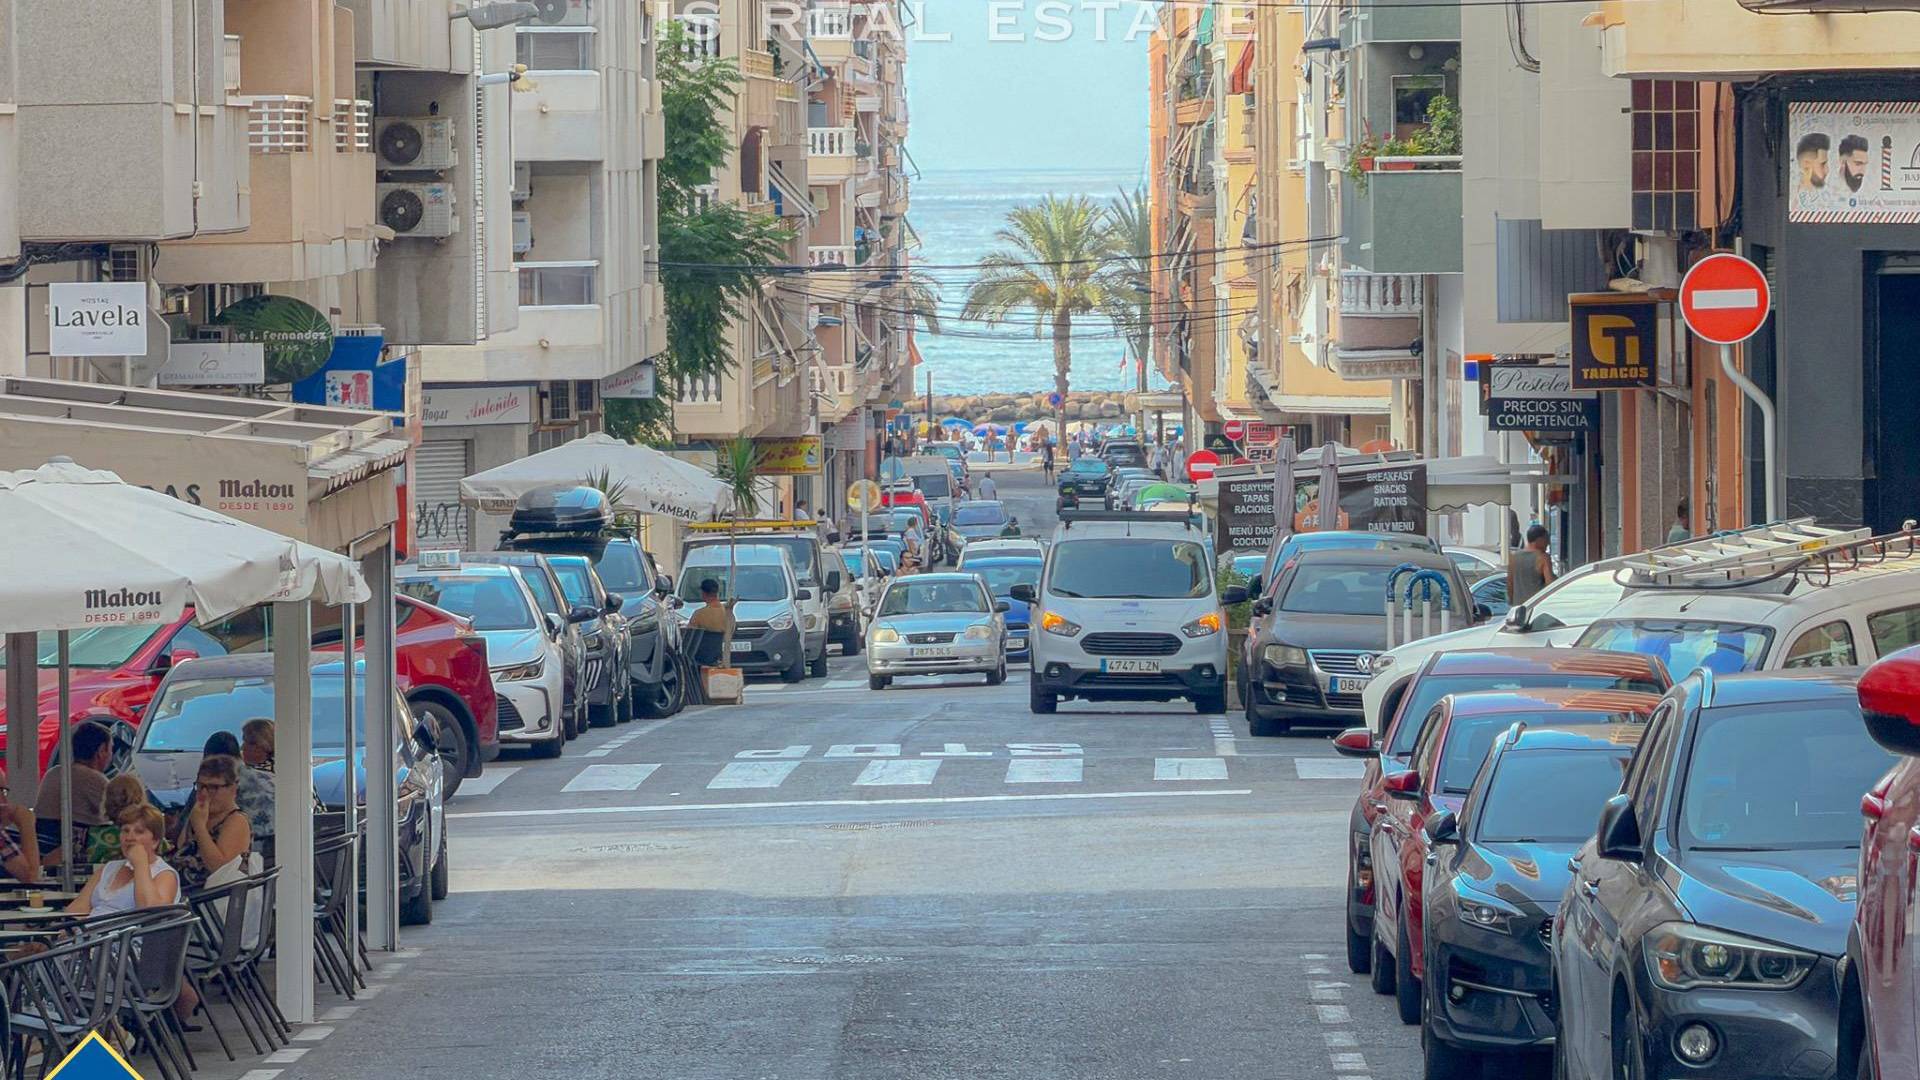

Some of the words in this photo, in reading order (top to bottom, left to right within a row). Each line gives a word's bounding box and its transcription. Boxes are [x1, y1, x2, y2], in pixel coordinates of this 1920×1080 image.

[54, 304, 140, 327] Lavela
[263, 329, 328, 341] Fernandez
[1581, 367, 1649, 379] TABACOS
[1492, 369, 1570, 393] Pasteler
[1503, 400, 1558, 413] PRECIOS
[1560, 400, 1583, 413] SIN
[1496, 414, 1589, 427] COMPETENCIA
[1366, 471, 1414, 482] BREAKFAST
[219, 479, 295, 498] Mahou
[1374, 483, 1408, 494] SNACKS
[141, 484, 201, 506] AS
[1242, 494, 1270, 503] TAPAS
[218, 502, 260, 511] DESDE
[265, 502, 295, 511] 1890
[1374, 496, 1408, 507] RATIONS
[657, 503, 699, 520] AMBAR
[1368, 522, 1391, 532] DAILY
[1391, 521, 1416, 532] MENU
[1232, 537, 1273, 547] COCKTAI
[84, 587, 162, 609] Mahou
[84, 612, 126, 623] DESDE
[132, 610, 161, 620] 1890
[1108, 661, 1135, 671] 4747
[1138, 661, 1160, 671] LZN
